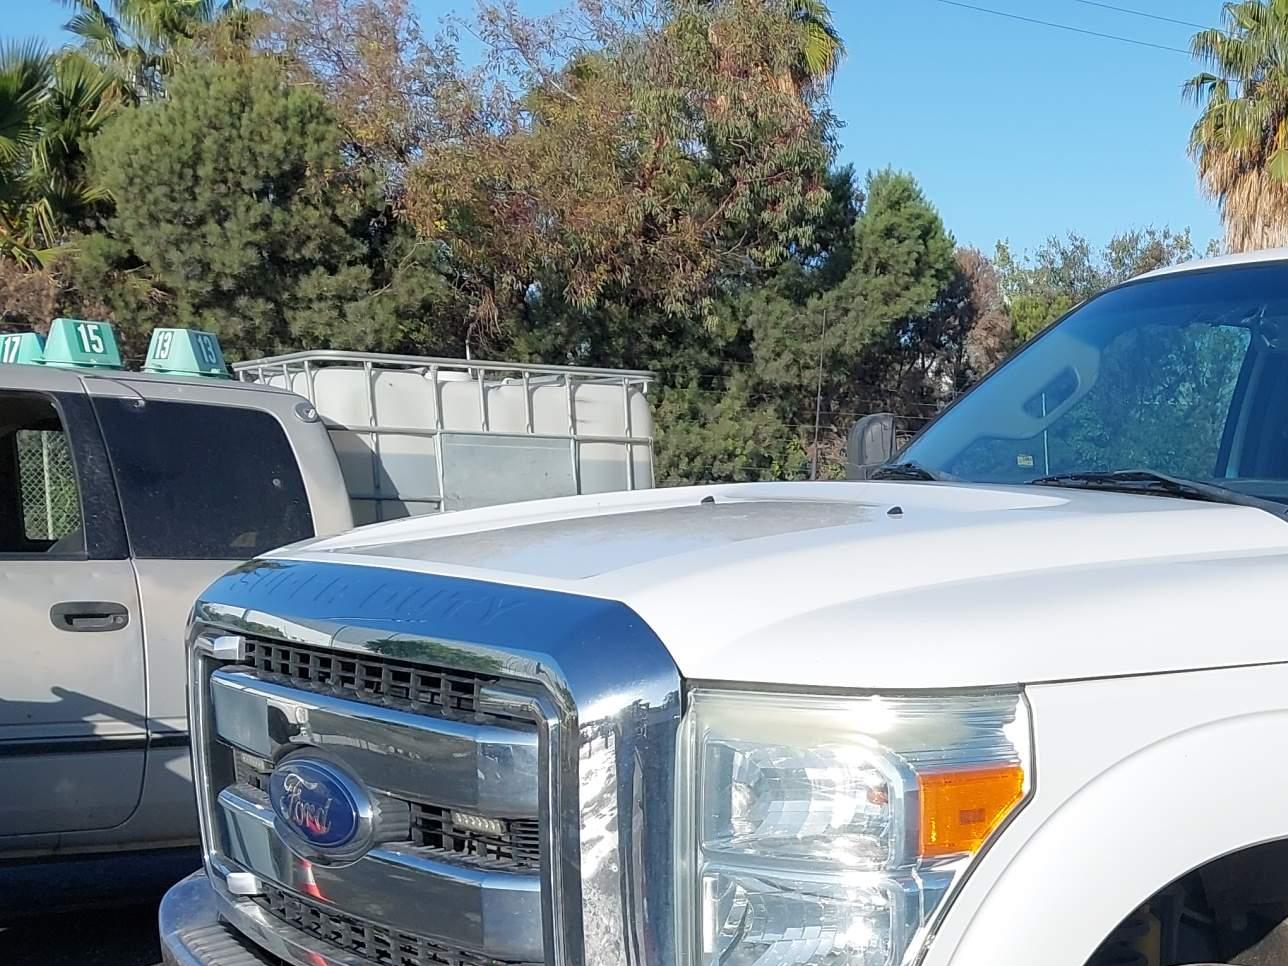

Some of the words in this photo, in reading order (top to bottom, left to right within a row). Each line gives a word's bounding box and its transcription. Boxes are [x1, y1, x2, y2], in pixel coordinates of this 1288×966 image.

[2, 336, 21, 364] 17
[77, 323, 104, 354] 15
[155, 331, 173, 359] 13
[197, 335, 217, 364] 13
[279, 773, 333, 835] Ford
